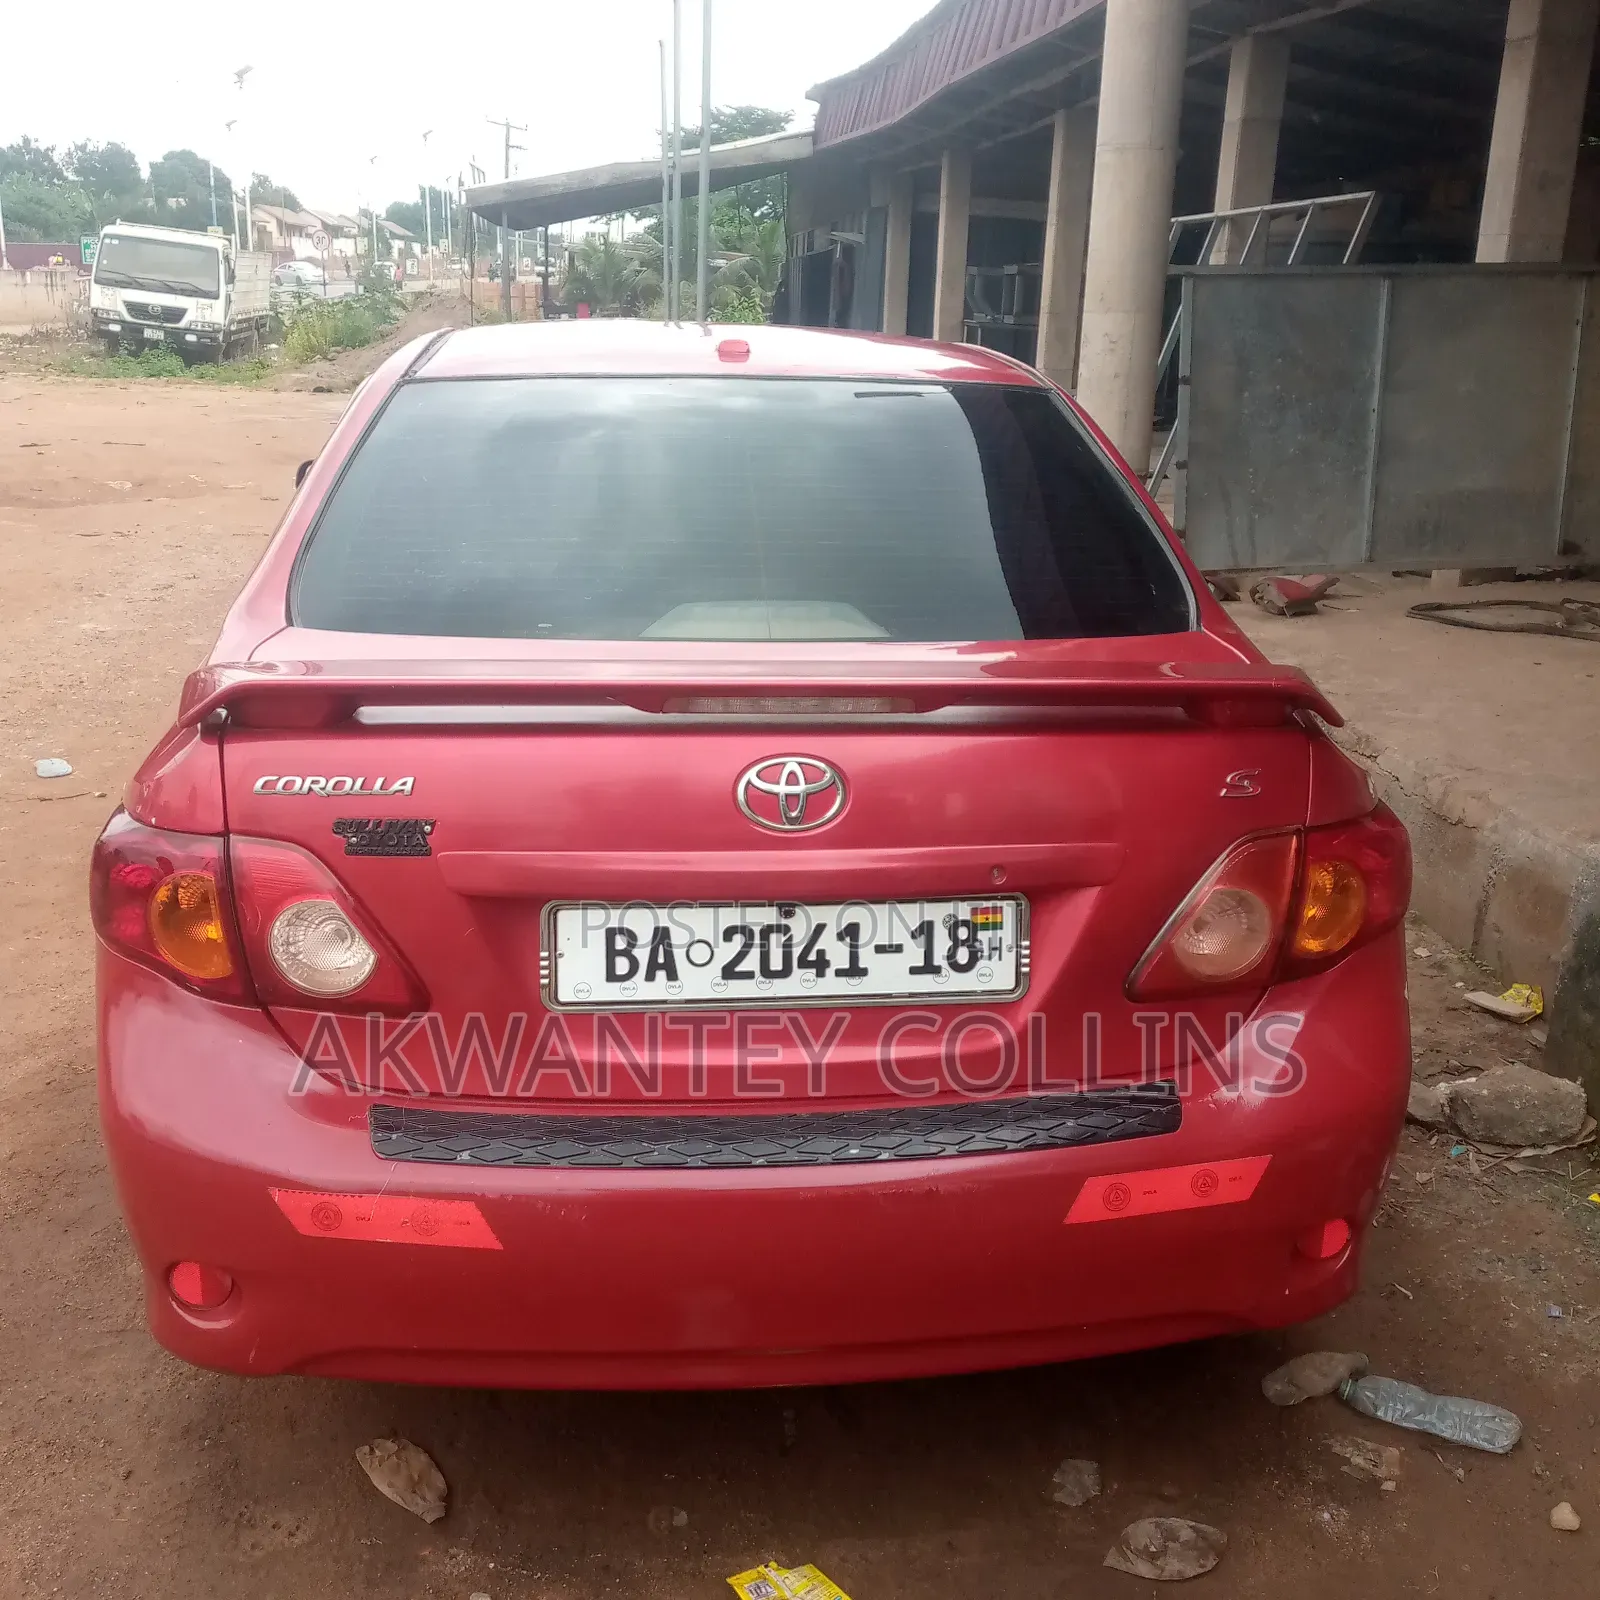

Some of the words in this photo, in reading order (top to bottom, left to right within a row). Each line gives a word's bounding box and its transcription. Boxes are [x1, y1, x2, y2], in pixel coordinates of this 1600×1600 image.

[253, 775, 416, 797] COROLLA
[1220, 768, 1261, 797] S
[605, 926, 679, 982] BA
[721, 919, 979, 980] 2041-18
